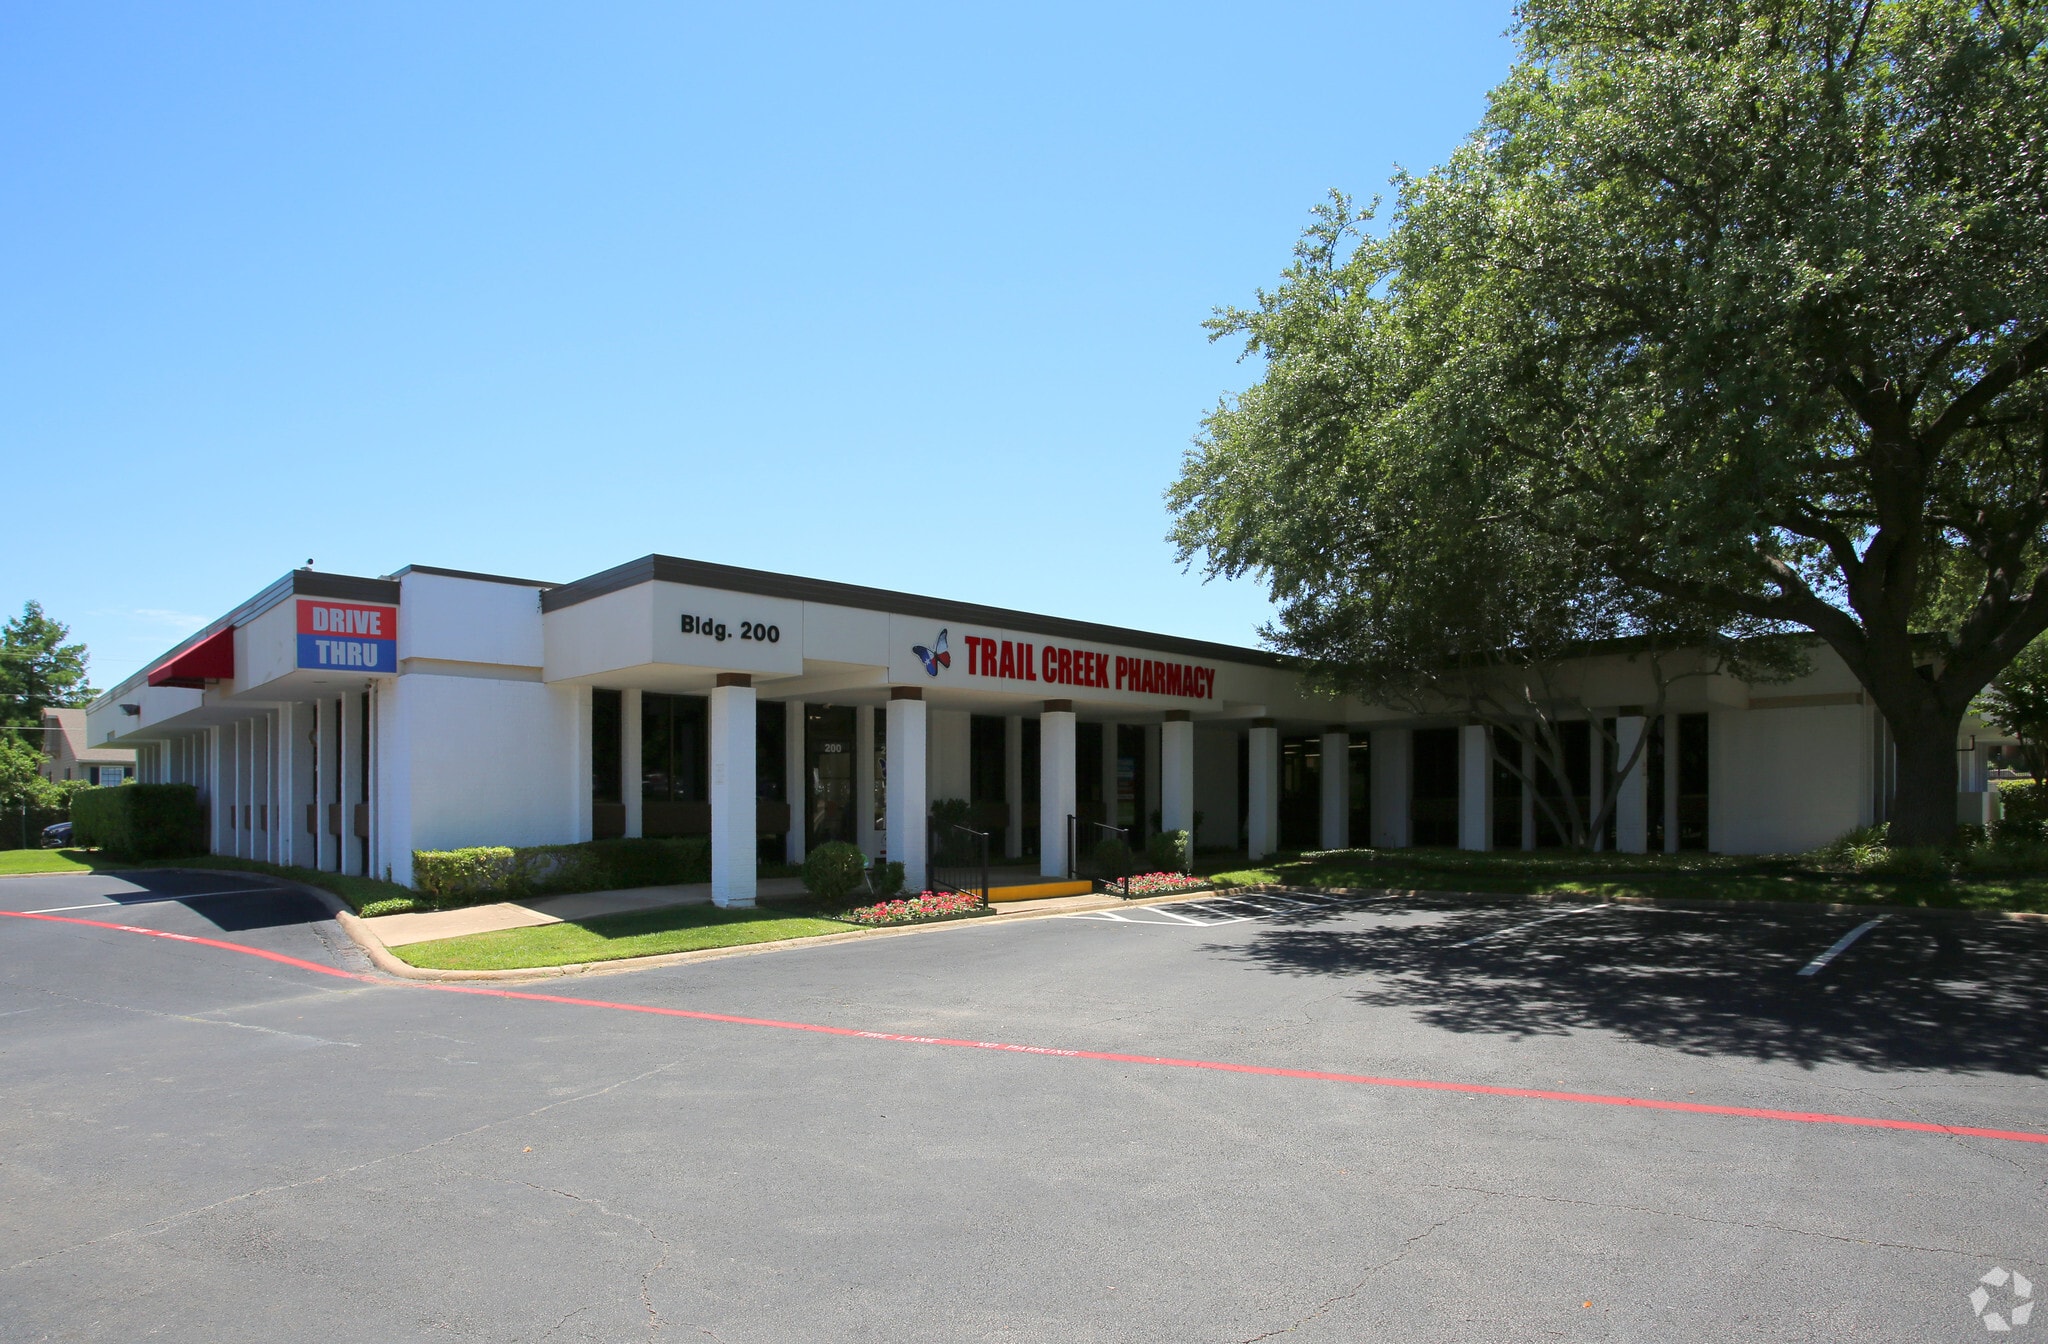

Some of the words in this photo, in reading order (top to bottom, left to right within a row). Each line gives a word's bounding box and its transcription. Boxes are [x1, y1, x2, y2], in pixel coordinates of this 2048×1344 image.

[313, 606, 381, 635] DRIVE
[681, 614, 732, 641] Bldg.
[740, 621, 780, 643] 200
[315, 640, 377, 667] THRU
[965, 635, 1037, 682] TRAIL
[1042, 645, 1110, 689] CREEK
[1115, 655, 1216, 700] PHARMACY
[824, 743, 842, 753] 200
[1005, 1044, 1079, 1056] PARKING
